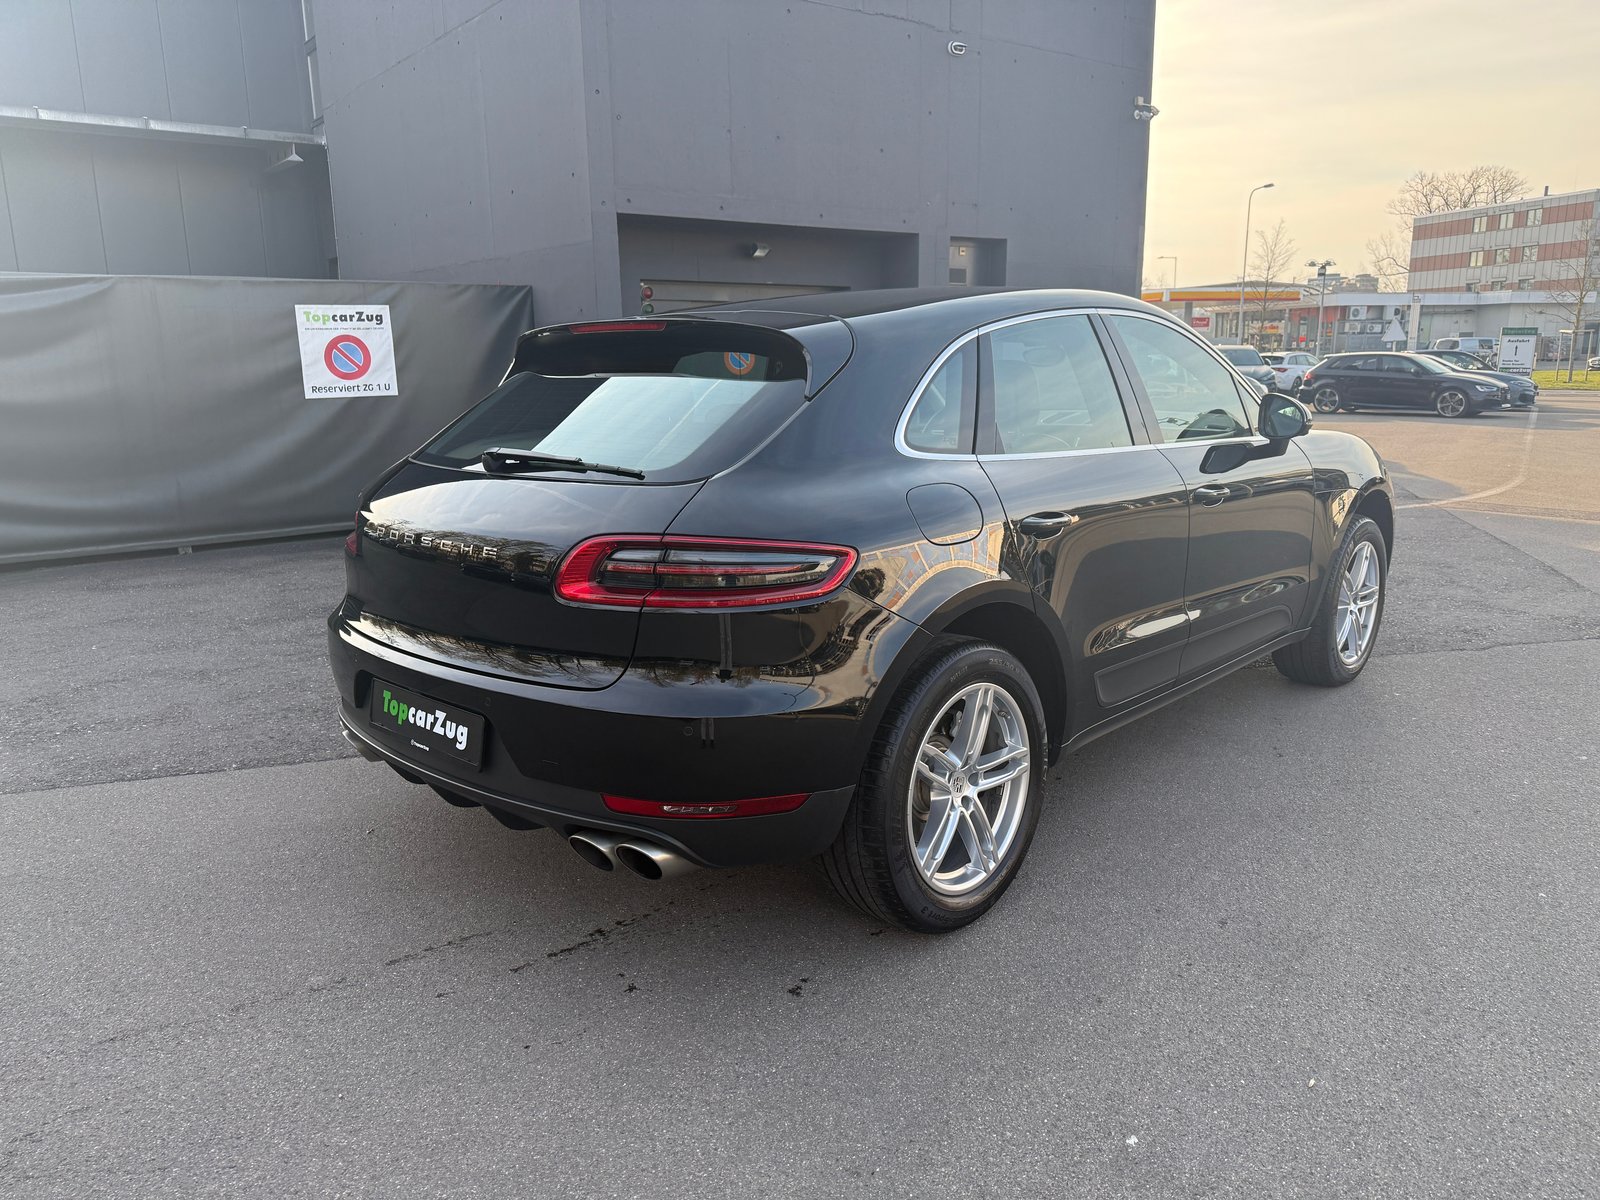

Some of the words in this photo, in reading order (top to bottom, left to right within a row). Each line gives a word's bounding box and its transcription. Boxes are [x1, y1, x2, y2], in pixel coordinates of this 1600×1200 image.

[303, 311, 384, 325] TopcarZug
[311, 384, 361, 394] Reserviert
[384, 383, 391, 391] U
[376, 526, 498, 559] PORSCHE
[383, 689, 469, 751] TopcarZug
